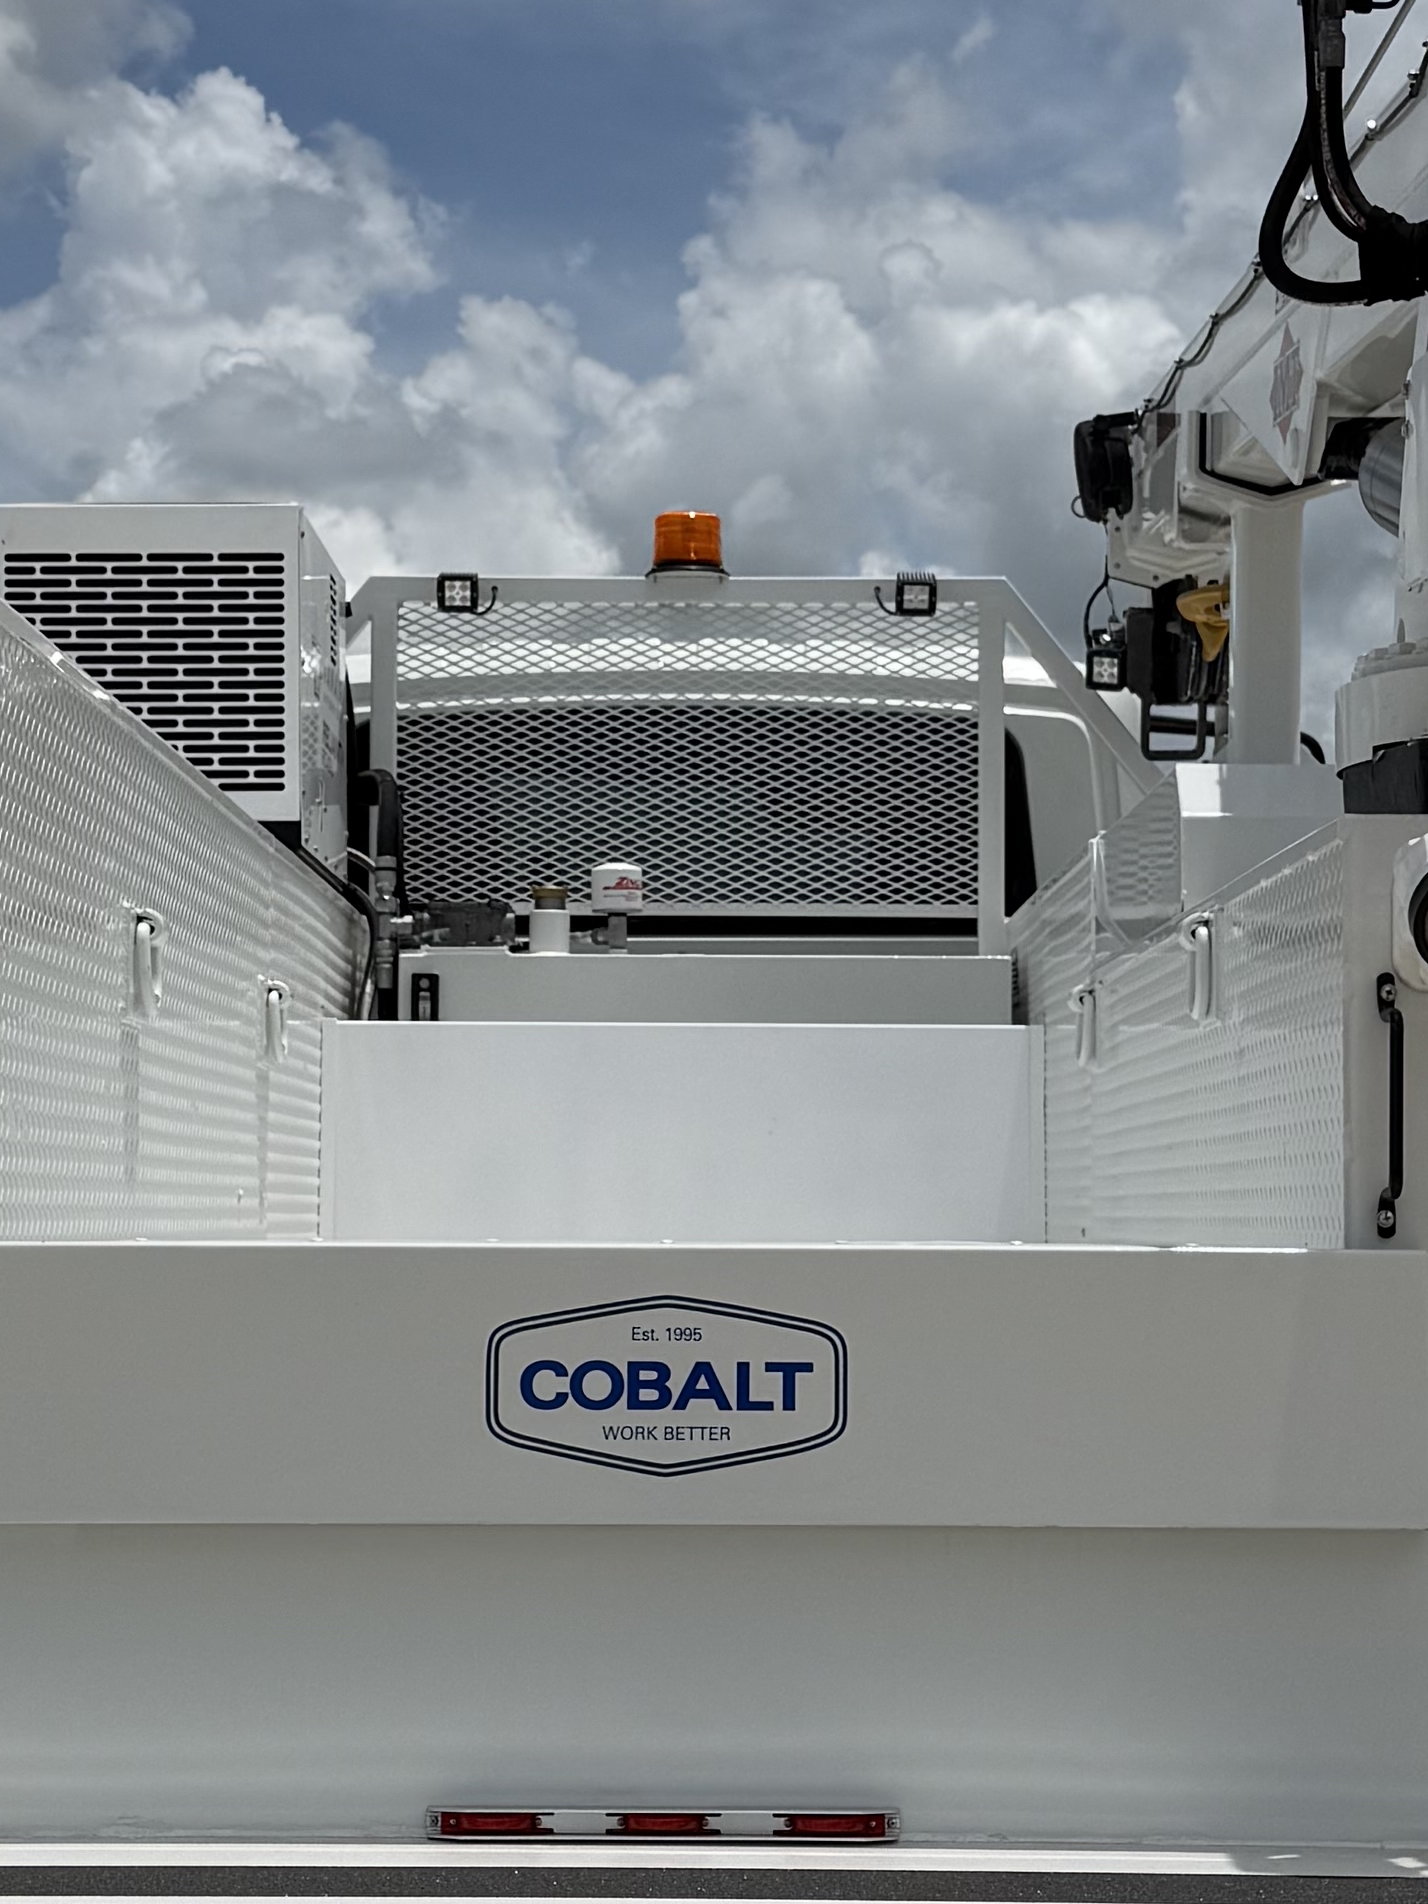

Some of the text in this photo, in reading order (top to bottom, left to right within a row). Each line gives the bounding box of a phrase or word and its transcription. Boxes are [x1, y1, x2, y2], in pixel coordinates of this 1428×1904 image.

[631, 1326, 703, 1342] Est. 1995
[520, 1359, 814, 1411] COBALT
[602, 1425, 731, 1441] WORK BETTER
